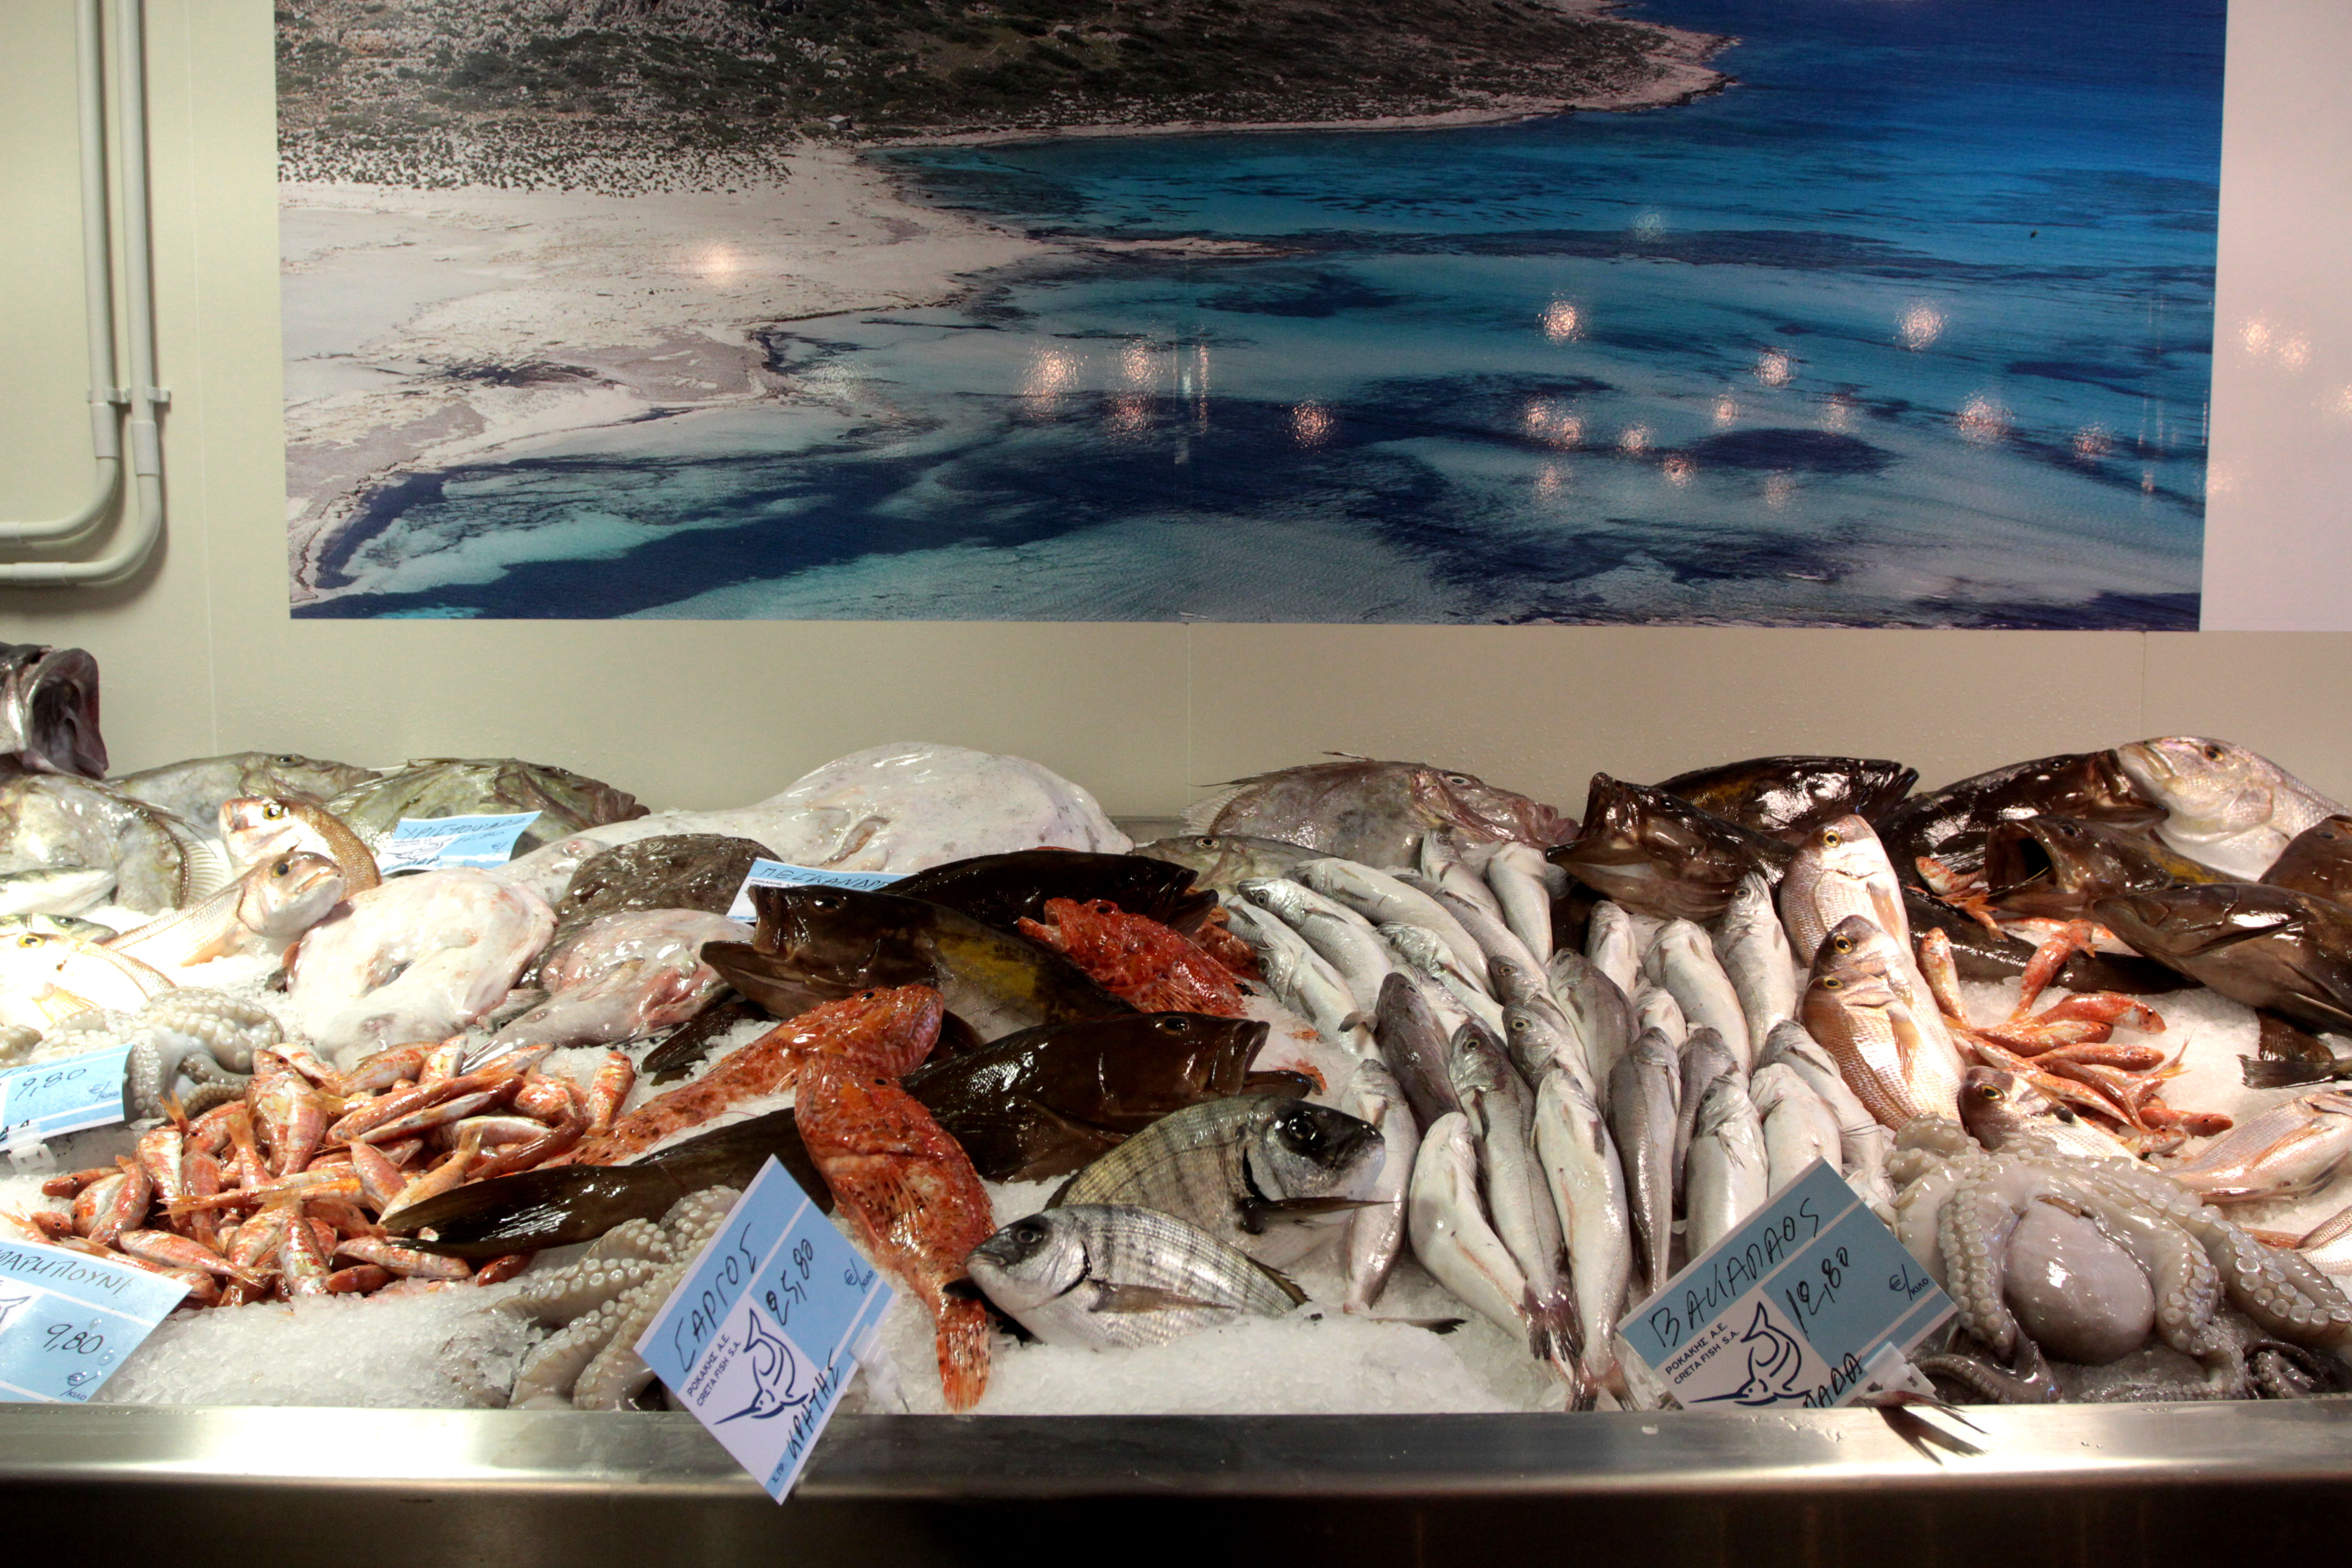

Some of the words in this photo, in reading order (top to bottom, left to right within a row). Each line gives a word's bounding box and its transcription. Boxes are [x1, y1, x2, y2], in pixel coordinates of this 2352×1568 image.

[759, 867, 891, 889] ΠΕΣΚΑΝΔΡΙ
[0, 1250, 134, 1294] ΠΑΡΜΠΟΥΝΙ
[43, 1324, 103, 1354] 9,80
[1665, 1337, 1709, 1375] ΡΟΚΑΚΗΣ
[1674, 1361, 1702, 1384] CRETA
[1700, 1343, 1721, 1362] FISH
[1722, 1331, 1740, 1344] S.A.
[687, 1351, 718, 1397] ΡΟΚΑΚΗΣ
[697, 1379, 717, 1406] CRETA
[714, 1357, 729, 1379] FISH
